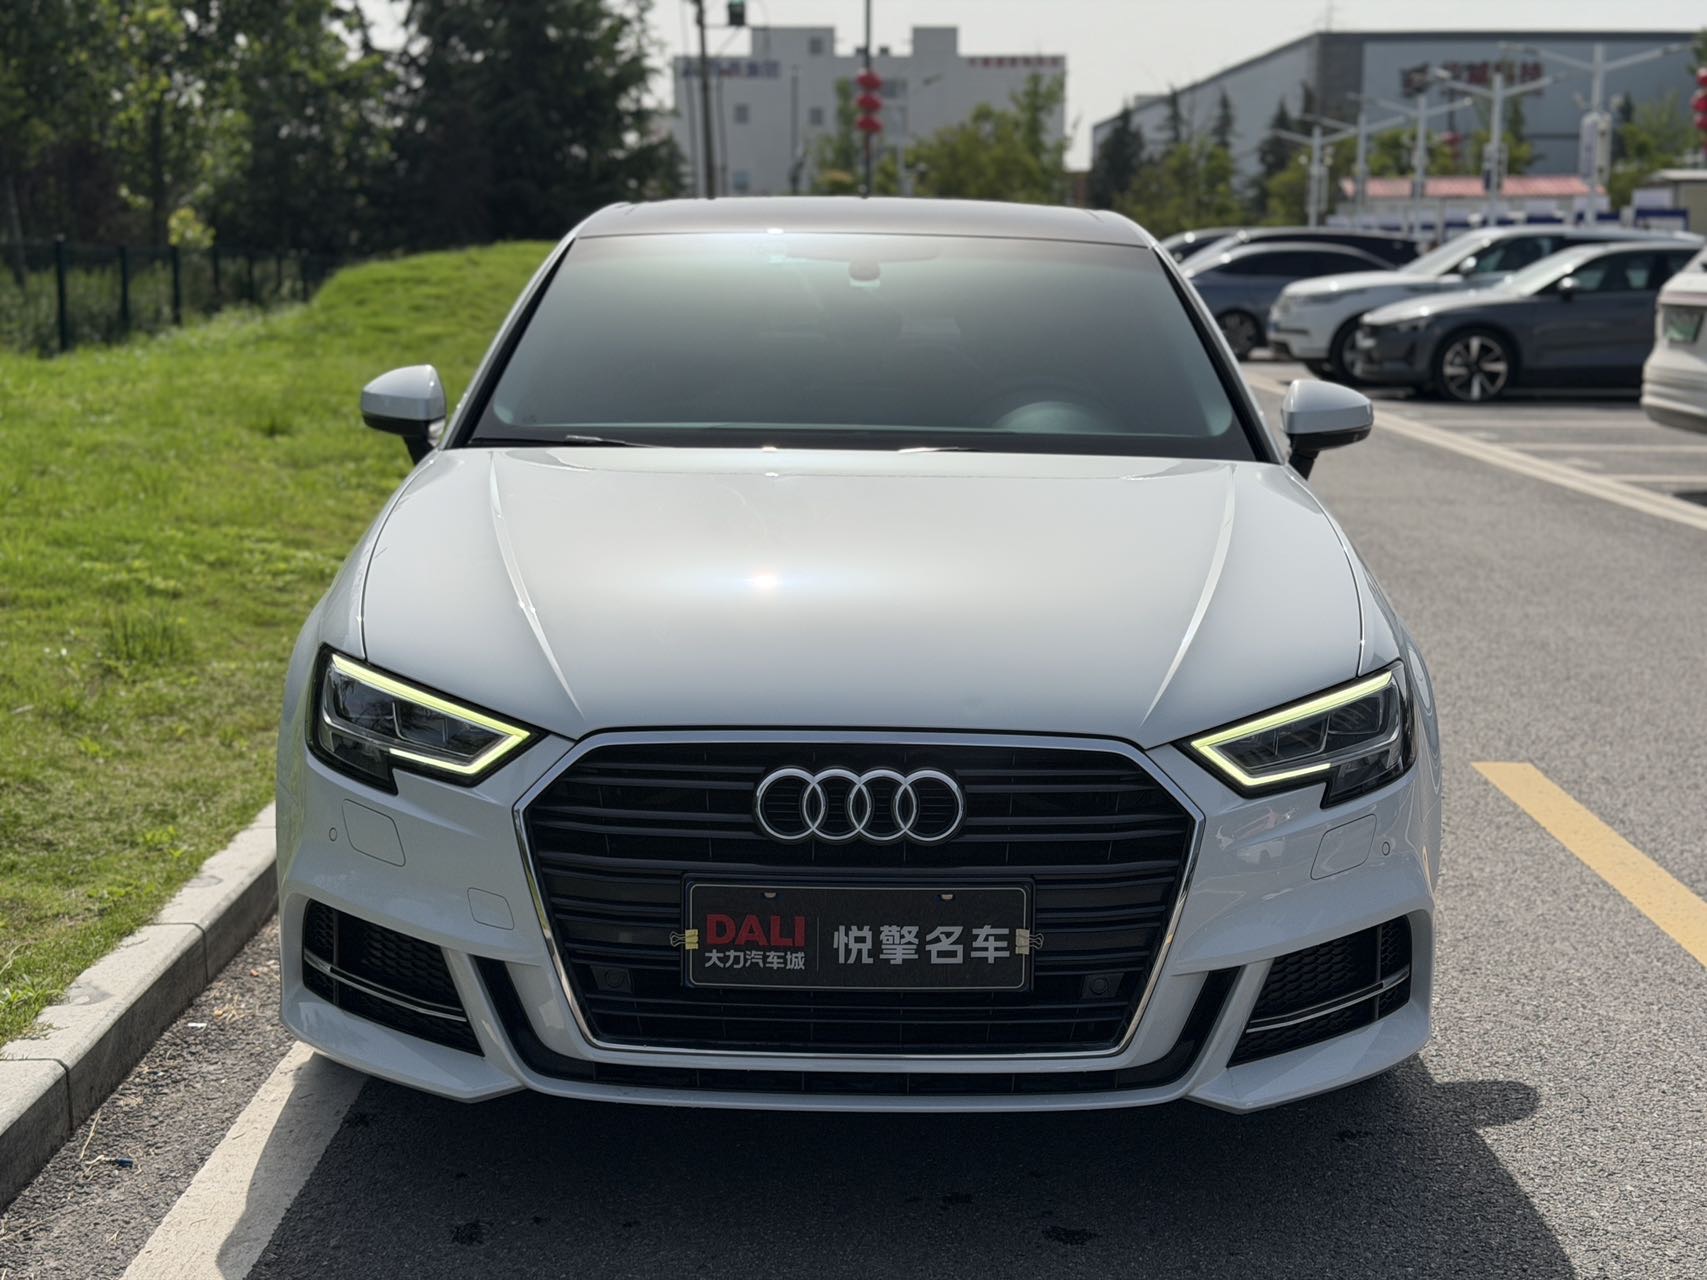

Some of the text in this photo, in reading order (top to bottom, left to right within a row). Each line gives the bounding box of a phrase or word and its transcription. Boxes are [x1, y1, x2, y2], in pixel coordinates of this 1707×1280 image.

[705, 913, 808, 947] DALI
[833, 924, 1010, 965] 悦擎名车
[704, 949, 806, 970] 大力汽车城
